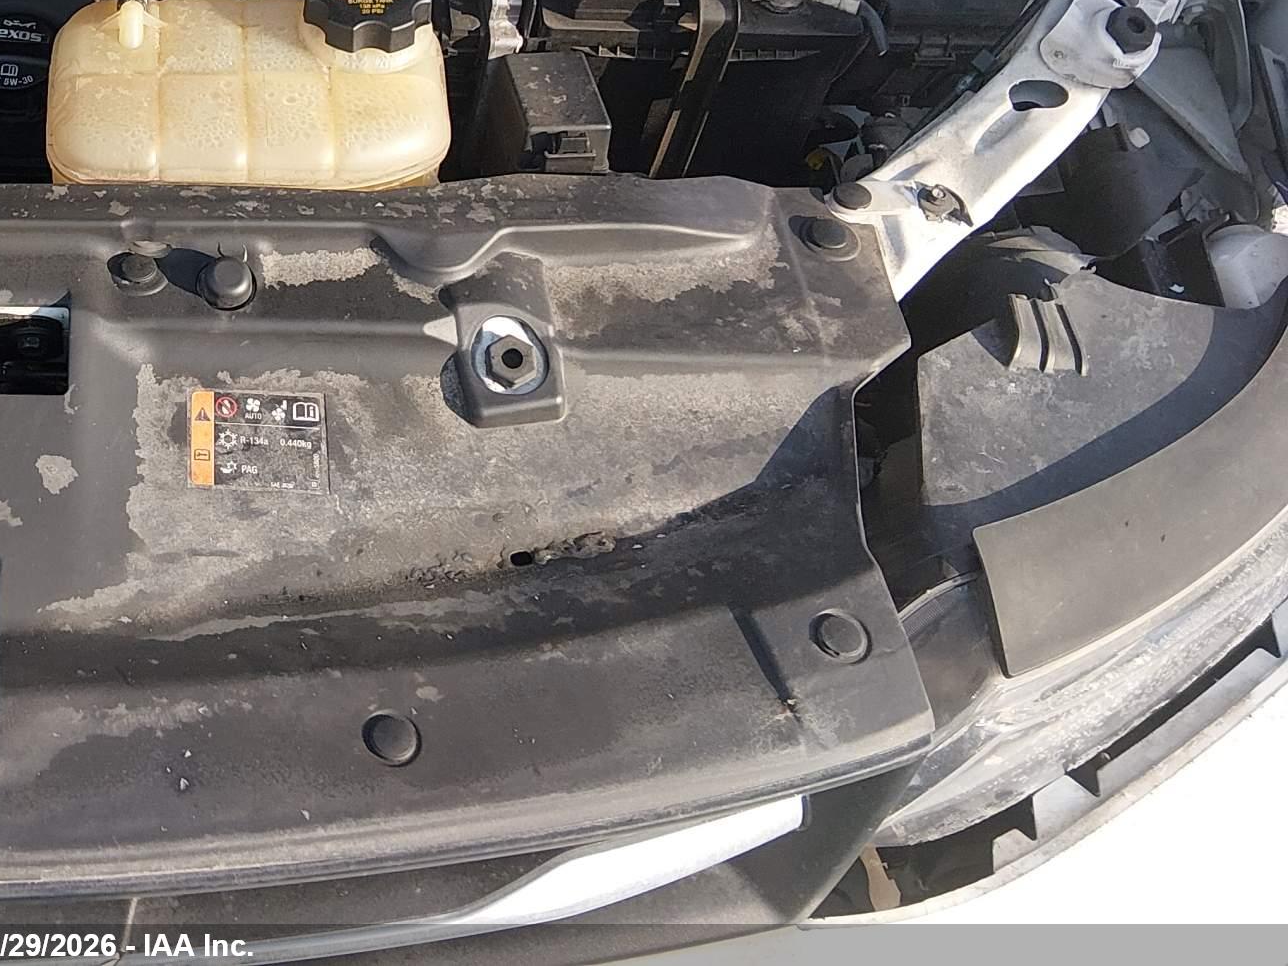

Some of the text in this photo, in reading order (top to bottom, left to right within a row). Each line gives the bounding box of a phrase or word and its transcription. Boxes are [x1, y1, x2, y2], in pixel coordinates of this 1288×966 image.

[3, 75, 34, 86] 5W-30
[240, 437, 269, 446] R-134a
[241, 465, 258, 474] PAG
